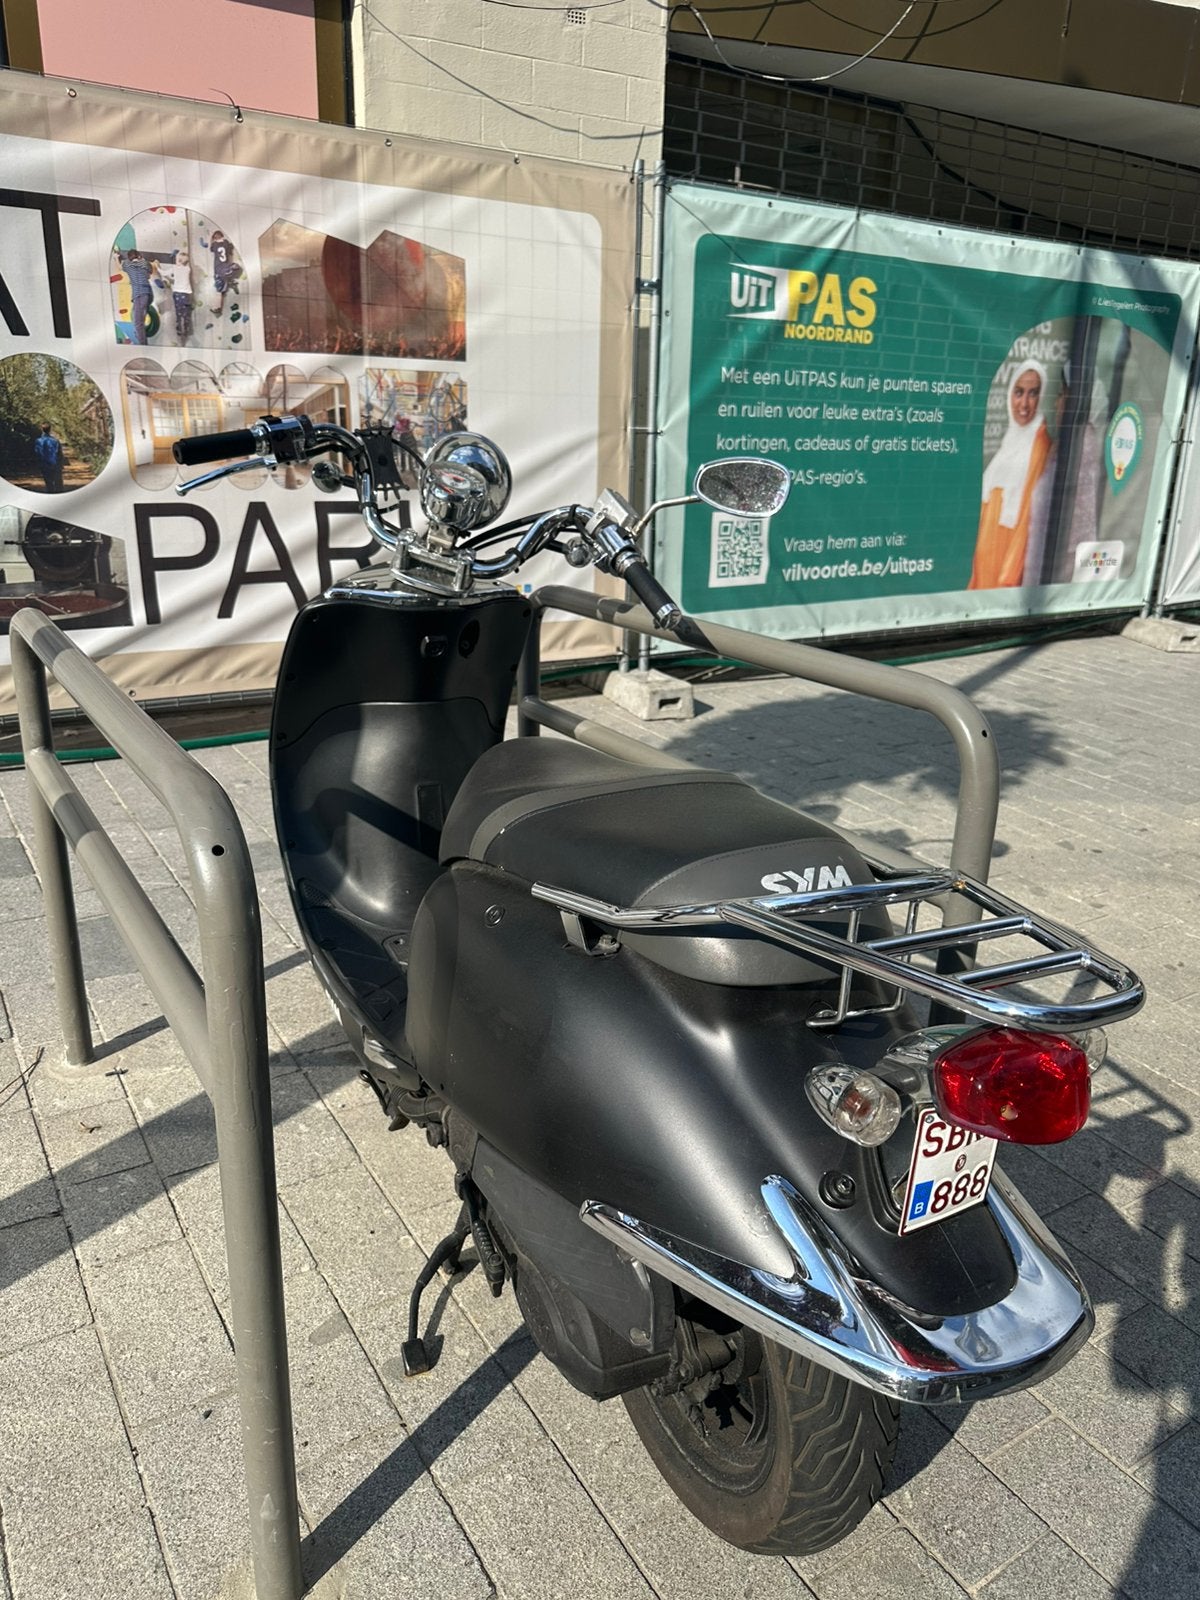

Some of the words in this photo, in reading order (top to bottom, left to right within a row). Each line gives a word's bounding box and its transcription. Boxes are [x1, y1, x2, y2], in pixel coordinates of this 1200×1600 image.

[217, 247, 227, 262] 3
[788, 269, 878, 329] PAS
[784, 324, 874, 345] NOORDRAND
[721, 367, 749, 385] Met
[753, 372, 780, 386] een
[784, 369, 837, 389] UiTPAS
[840, 373, 865, 390] kun
[867, 375, 880, 393] je
[883, 377, 928, 395] punten
[931, 381, 972, 396] sparen
[718, 404, 737, 418] en
[741, 400, 782, 419] ruilen
[786, 406, 818, 420] voor
[822, 401, 858, 420] leuke
[906, 407, 944, 424] (zoals
[716, 433, 790, 453] kortingen,
[794, 434, 850, 452] cadeaus
[855, 435, 870, 451] of
[871, 437, 907, 453] gratis
[784, 537, 824, 553] Vraag
[827, 535, 857, 550] hem
[860, 536, 881, 549] aan
[884, 531, 906, 547] via:
[782, 556, 933, 583] vilvoorde.be/uitpas
[761, 865, 853, 895] SYM
[930, 1165, 988, 1214] 888
[914, 1202, 924, 1214] B
